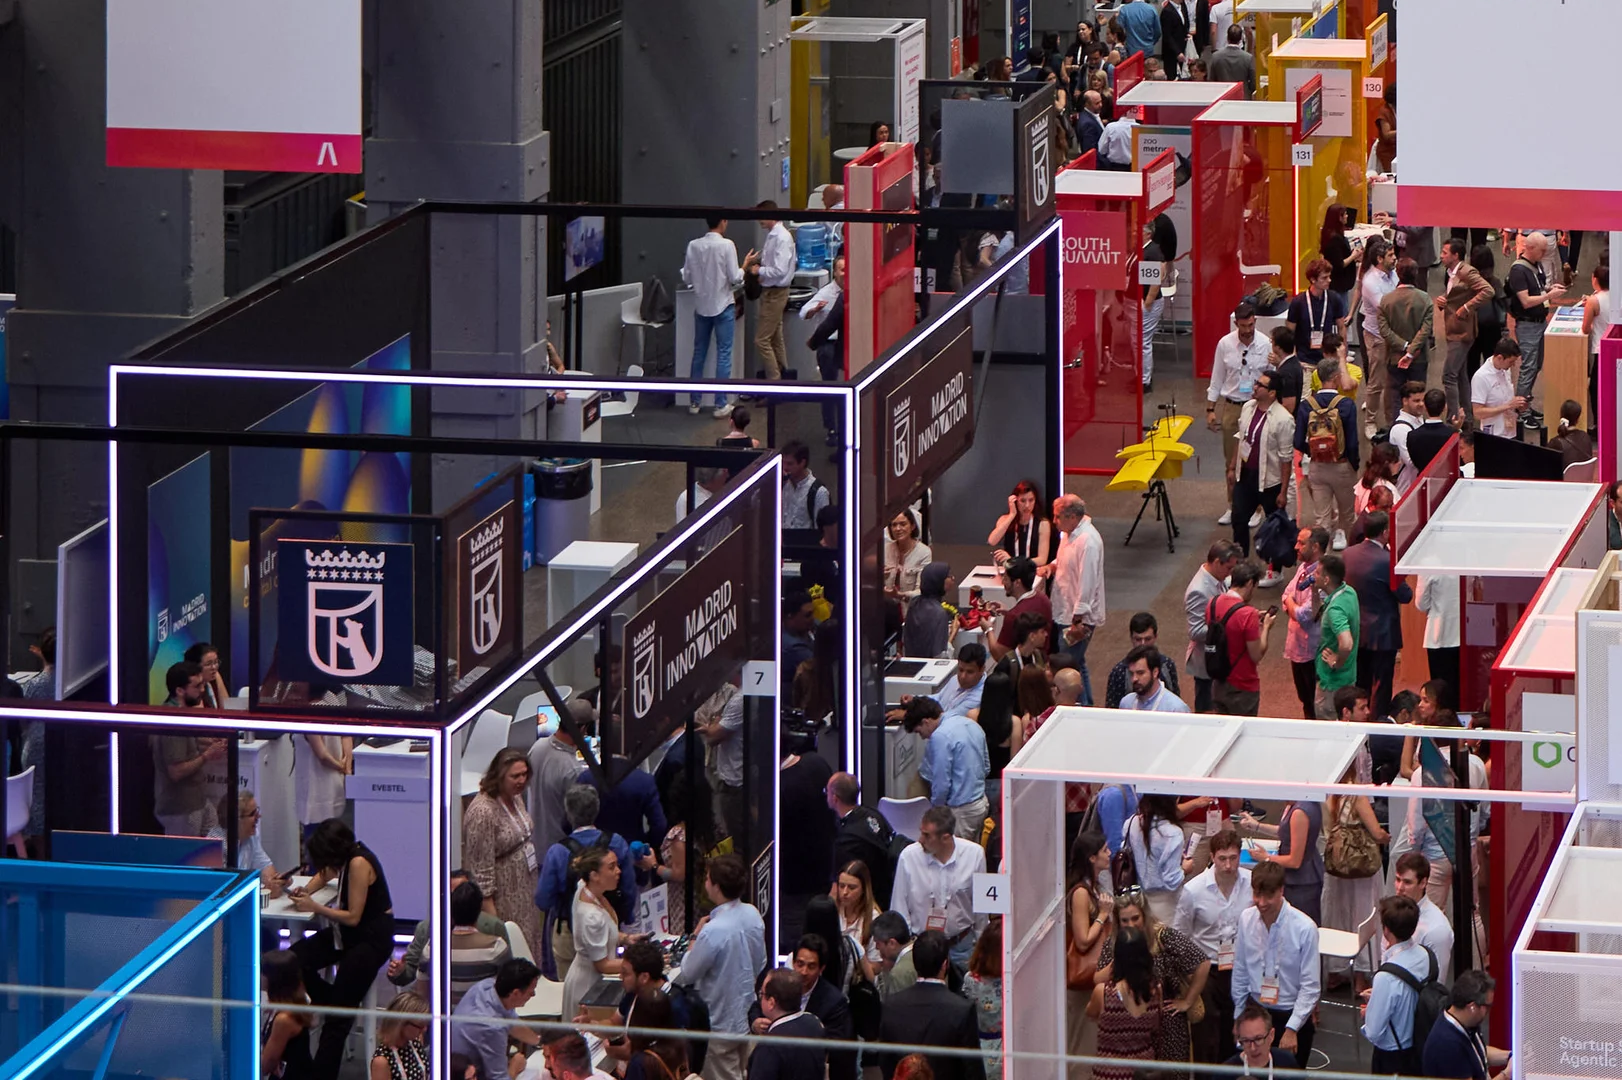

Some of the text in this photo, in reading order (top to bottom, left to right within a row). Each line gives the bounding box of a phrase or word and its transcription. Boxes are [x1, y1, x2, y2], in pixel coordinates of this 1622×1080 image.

[1365, 84, 1381, 92] 130
[1296, 151, 1311, 160] 131
[1141, 268, 1160, 278] 189
[932, 372, 964, 418] MADRID
[919, 393, 967, 457] INNOVATION
[182, 593, 205, 616] MADRID
[686, 580, 732, 642] MADRID
[173, 602, 207, 633] INNOVATION
[667, 604, 737, 691] INNOVATION
[755, 672, 764, 685] 7
[372, 784, 406, 793] EVESTEL
[985, 886, 998, 901] 4
[1560, 1036, 1614, 1052] Startup
[1560, 1052, 1616, 1068] Agentic
